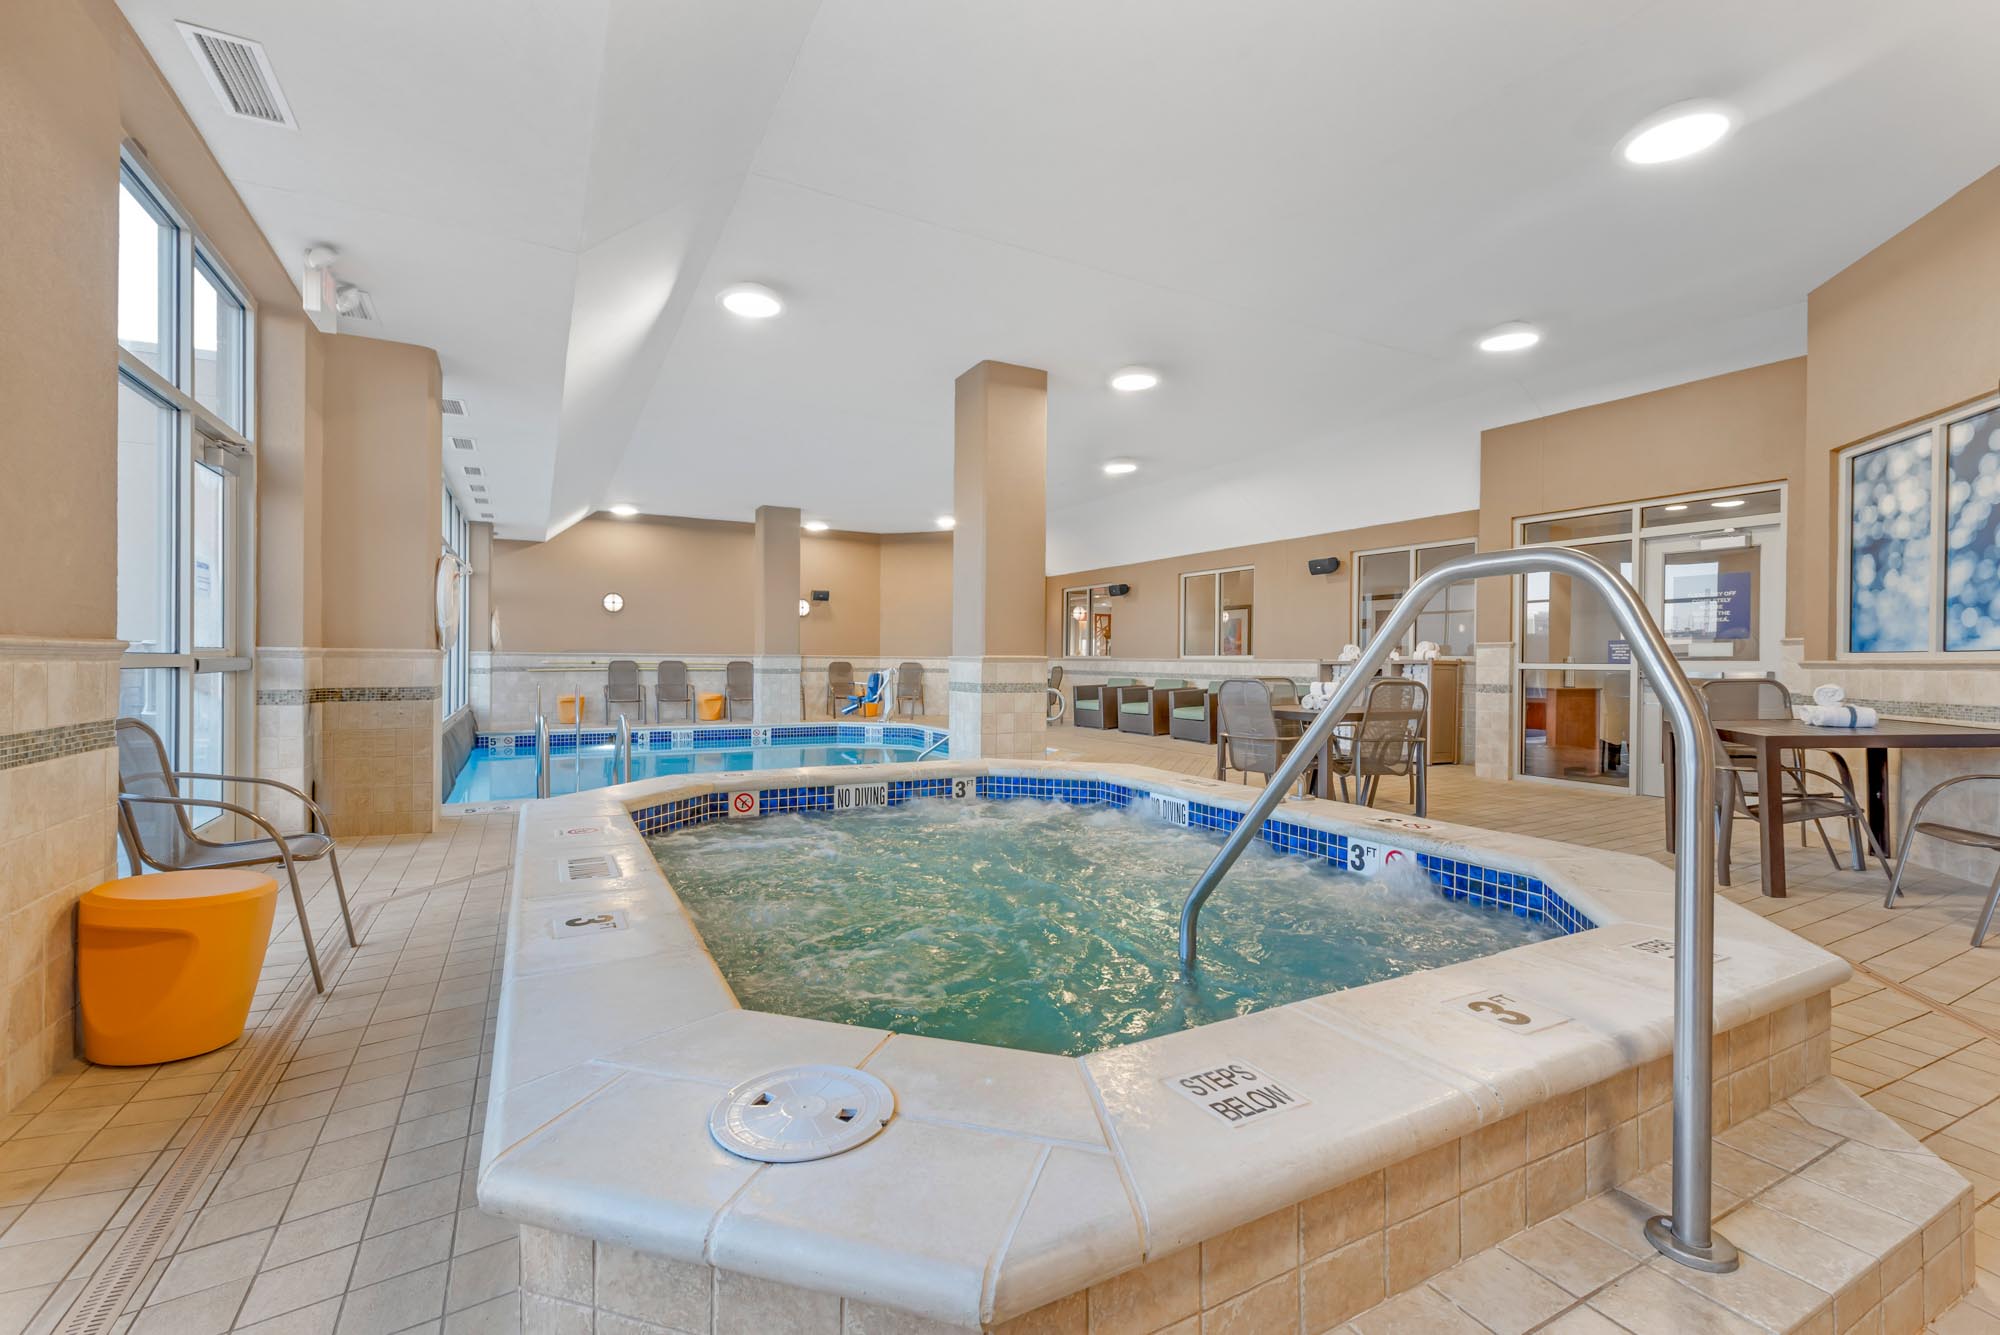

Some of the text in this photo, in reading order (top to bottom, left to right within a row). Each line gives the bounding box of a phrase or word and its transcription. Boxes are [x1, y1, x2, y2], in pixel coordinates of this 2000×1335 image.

[490, 737, 497, 747] 5
[837, 785, 886, 809] NO DIVING
[955, 779, 975, 799] 3 FT
[1162, 799, 1186, 825] DIVING
[1350, 844, 1377, 872] 3 FT
[1467, 1001, 1532, 1026] 3
[1179, 1064, 1258, 1097] STEPS
[1208, 1084, 1295, 1122] BELOW
